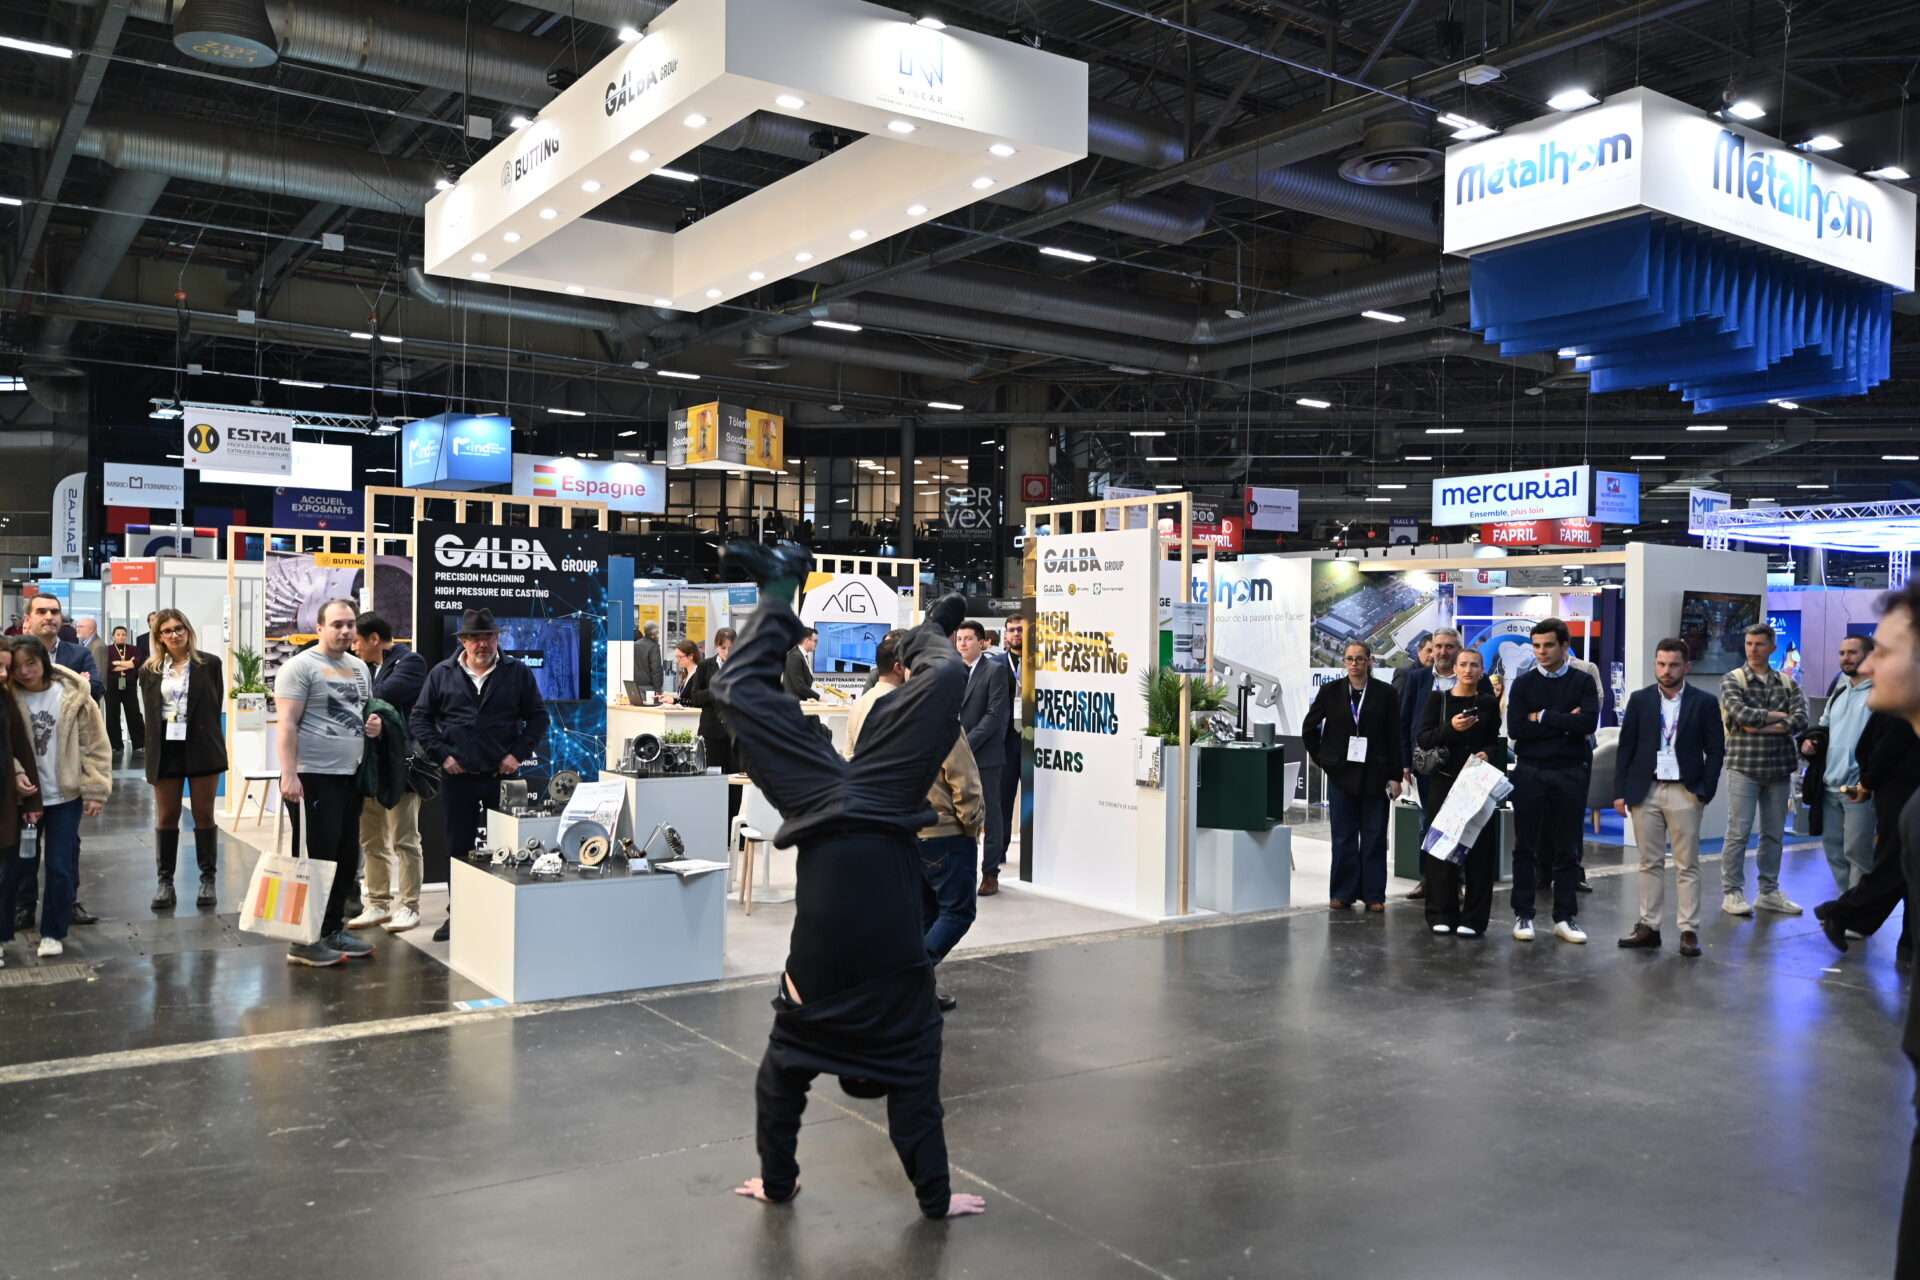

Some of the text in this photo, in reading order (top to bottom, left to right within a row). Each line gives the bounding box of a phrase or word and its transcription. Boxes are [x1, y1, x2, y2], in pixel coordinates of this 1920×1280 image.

[515, 137, 559, 182] BUTTING
[227, 427, 290, 446] ESTRAL
[562, 475, 646, 499] Espagne
[291, 503, 353, 515] EXPOSANTS
[301, 495, 345, 506] ACCUEIL
[1469, 508, 1510, 519] Ensemble,
[1511, 508, 1528, 518] plus
[1492, 527, 1537, 543] FAPRIL
[1559, 527, 1592, 544] FAPRIL
[434, 533, 598, 573] GALBA GROUP
[1044, 547, 1124, 573] GALBA GROUP
[435, 572, 525, 583] PRECISION MACHINING
[434, 586, 549, 598] HIGH PRESSURE DIE CASTING
[434, 600, 463, 610] GEARS
[822, 594, 866, 613] AIG
[1036, 611, 1069, 633] HIGH
[1507, 624, 1518, 632] de
[1036, 631, 1114, 655] PRESSURE
[1035, 649, 1128, 675] DIE CASTING
[1034, 688, 1116, 715] PRECISION
[1034, 708, 1119, 736] MACHINING
[1034, 747, 1084, 774] GEARS
